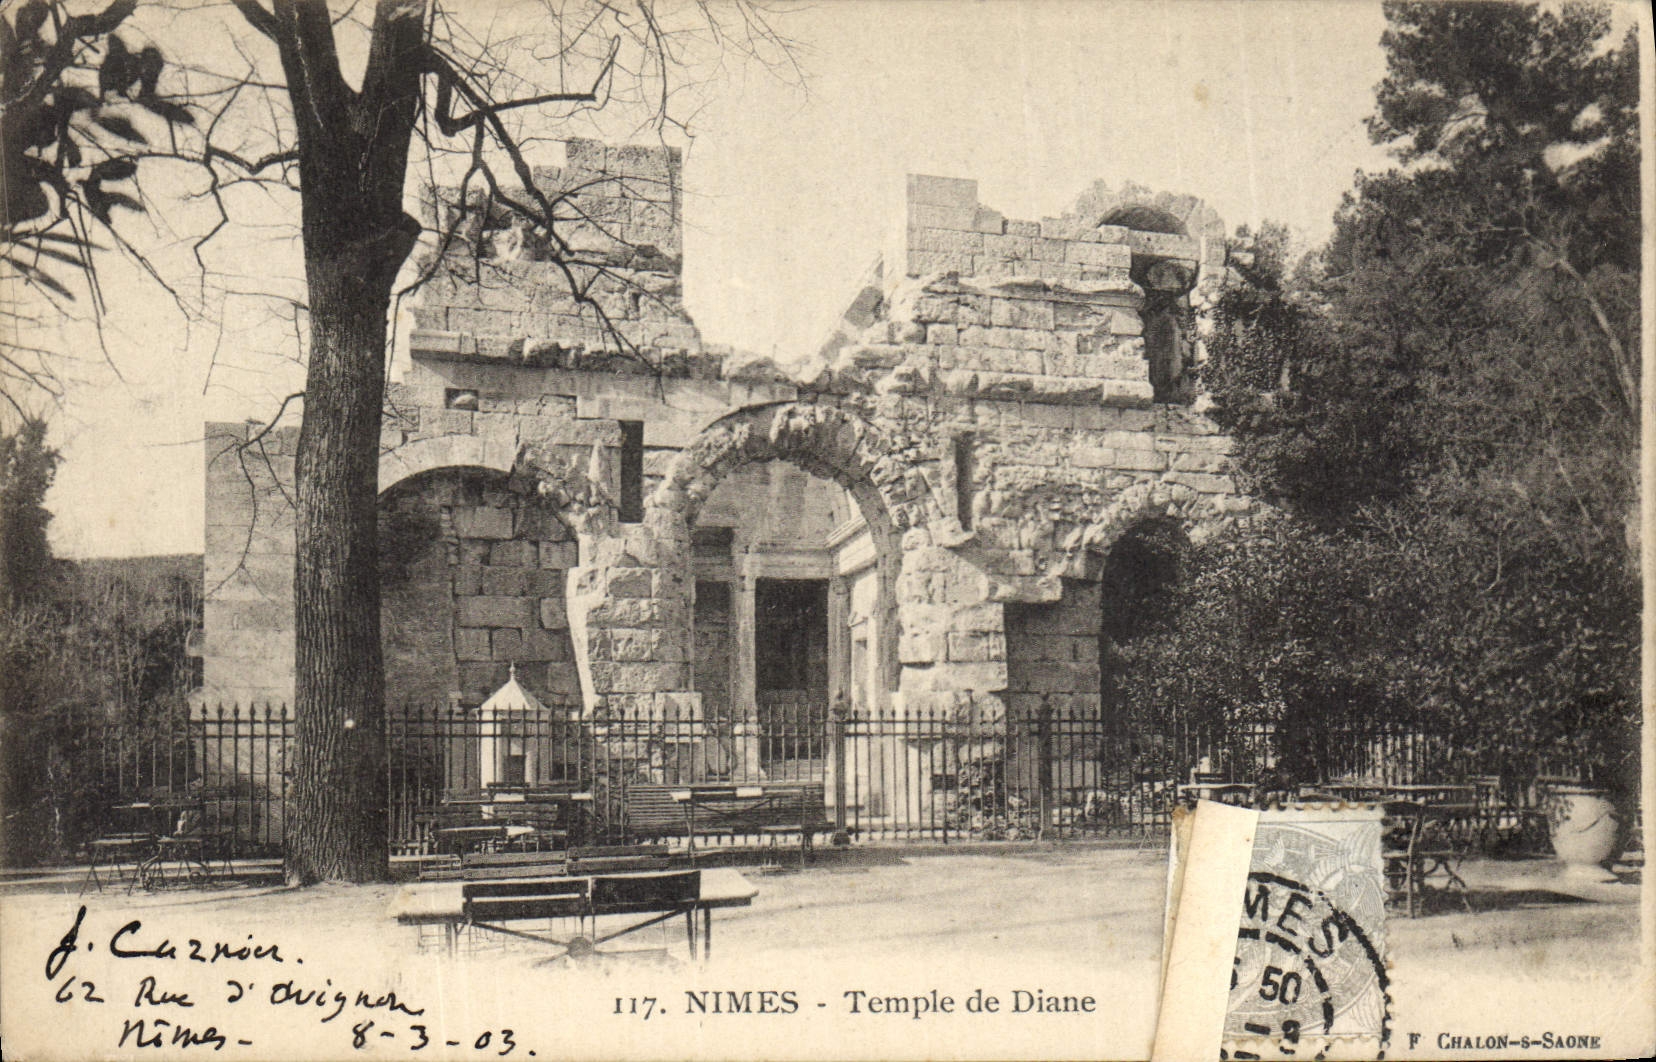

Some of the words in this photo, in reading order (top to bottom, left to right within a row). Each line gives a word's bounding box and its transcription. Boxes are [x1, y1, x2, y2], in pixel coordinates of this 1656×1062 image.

[55, 975, 105, 1003] 62
[134, 976, 194, 1008] Rue
[1258, 965, 1302, 1005] 50
